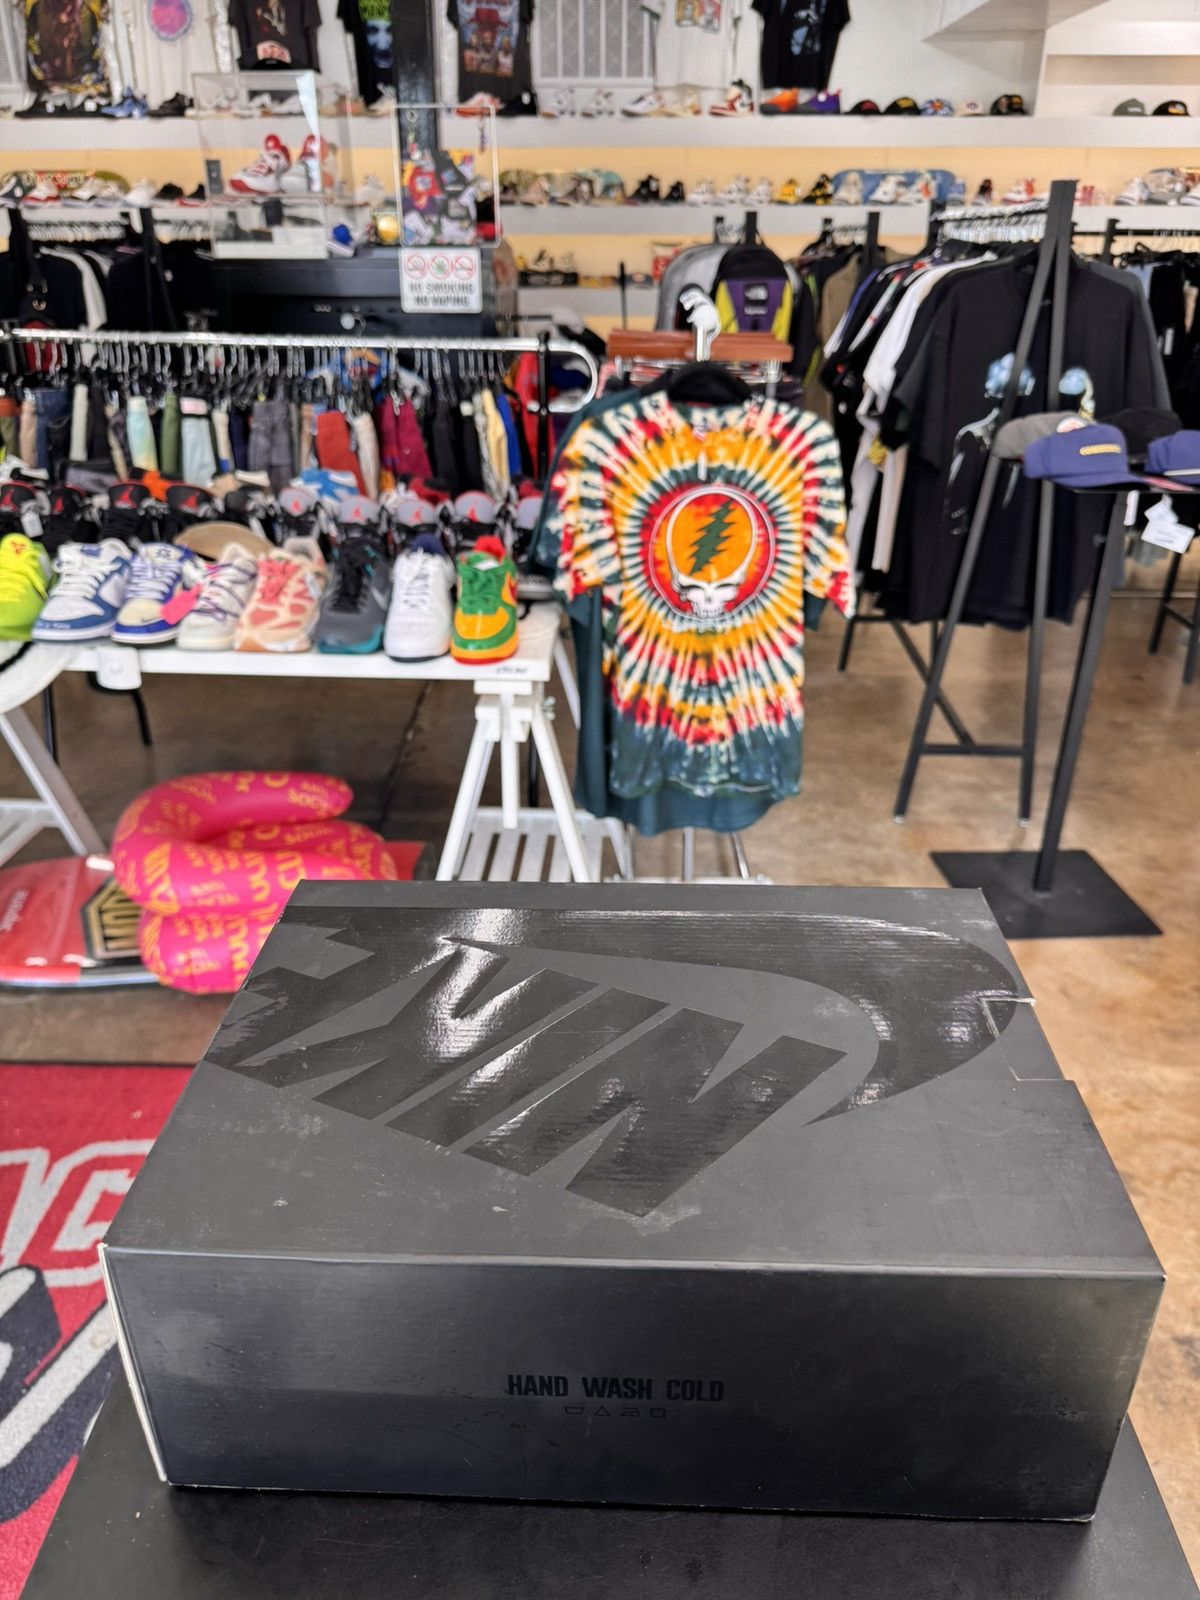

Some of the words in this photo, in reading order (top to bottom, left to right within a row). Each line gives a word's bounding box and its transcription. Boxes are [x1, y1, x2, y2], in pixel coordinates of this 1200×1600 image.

[507, 1374, 569, 1397] HAND
[581, 1377, 652, 1400] WASH
[666, 1379, 724, 1402] COLD
